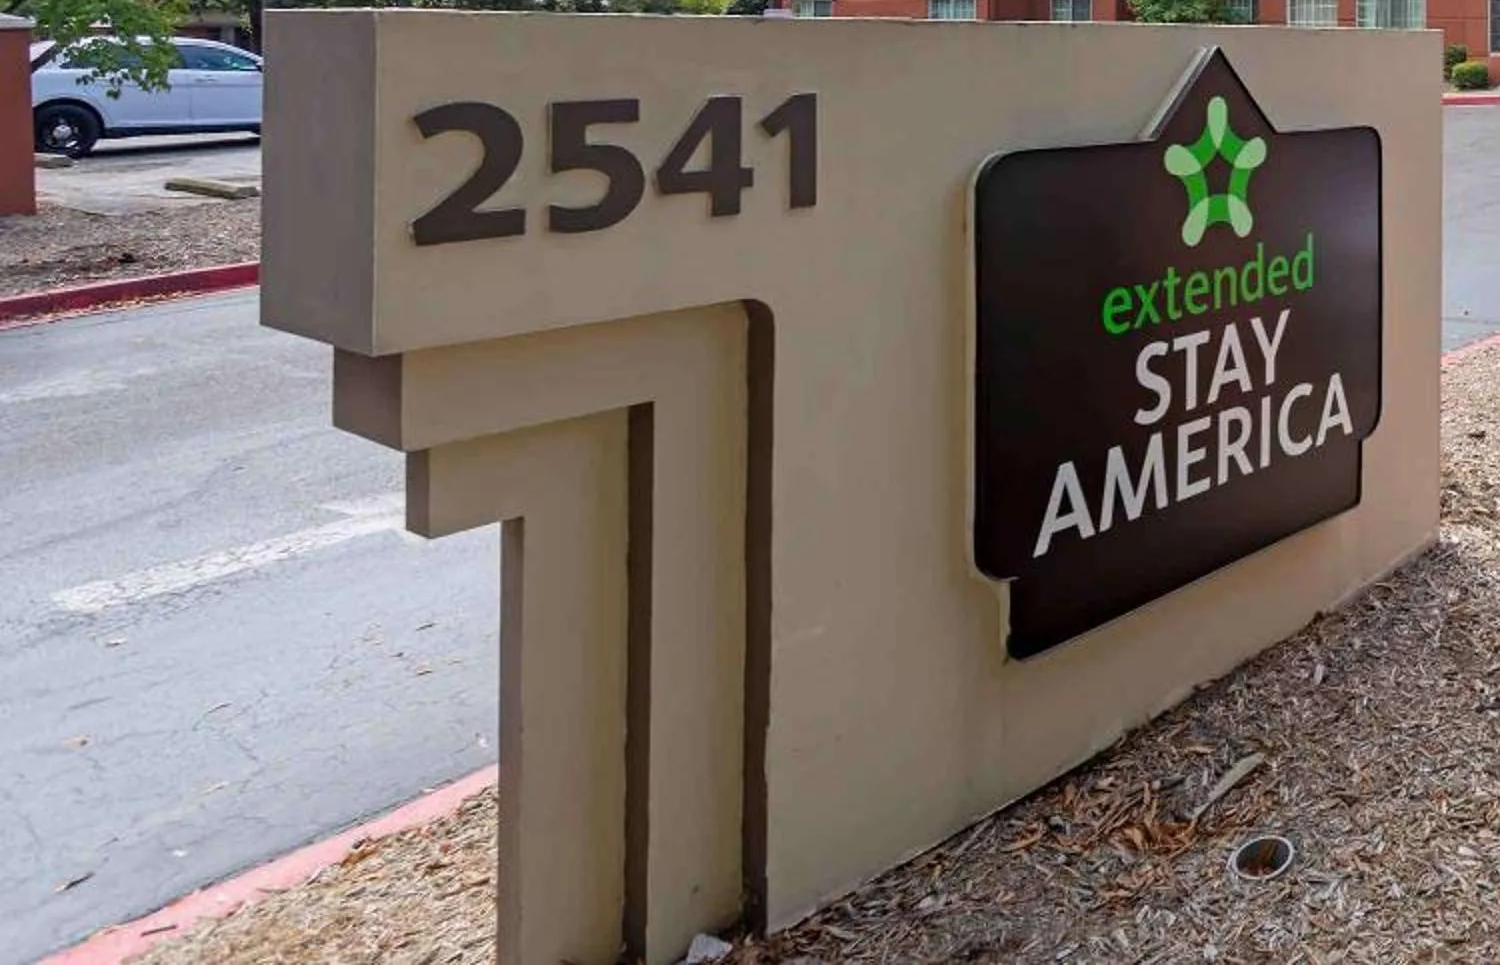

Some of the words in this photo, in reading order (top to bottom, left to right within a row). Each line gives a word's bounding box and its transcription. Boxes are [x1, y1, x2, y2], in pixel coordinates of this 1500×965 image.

[412, 93, 817, 246] 2541
[1102, 233, 1314, 334] extended
[1133, 309, 1290, 427] STAY
[1032, 372, 1353, 558] AMERICA
